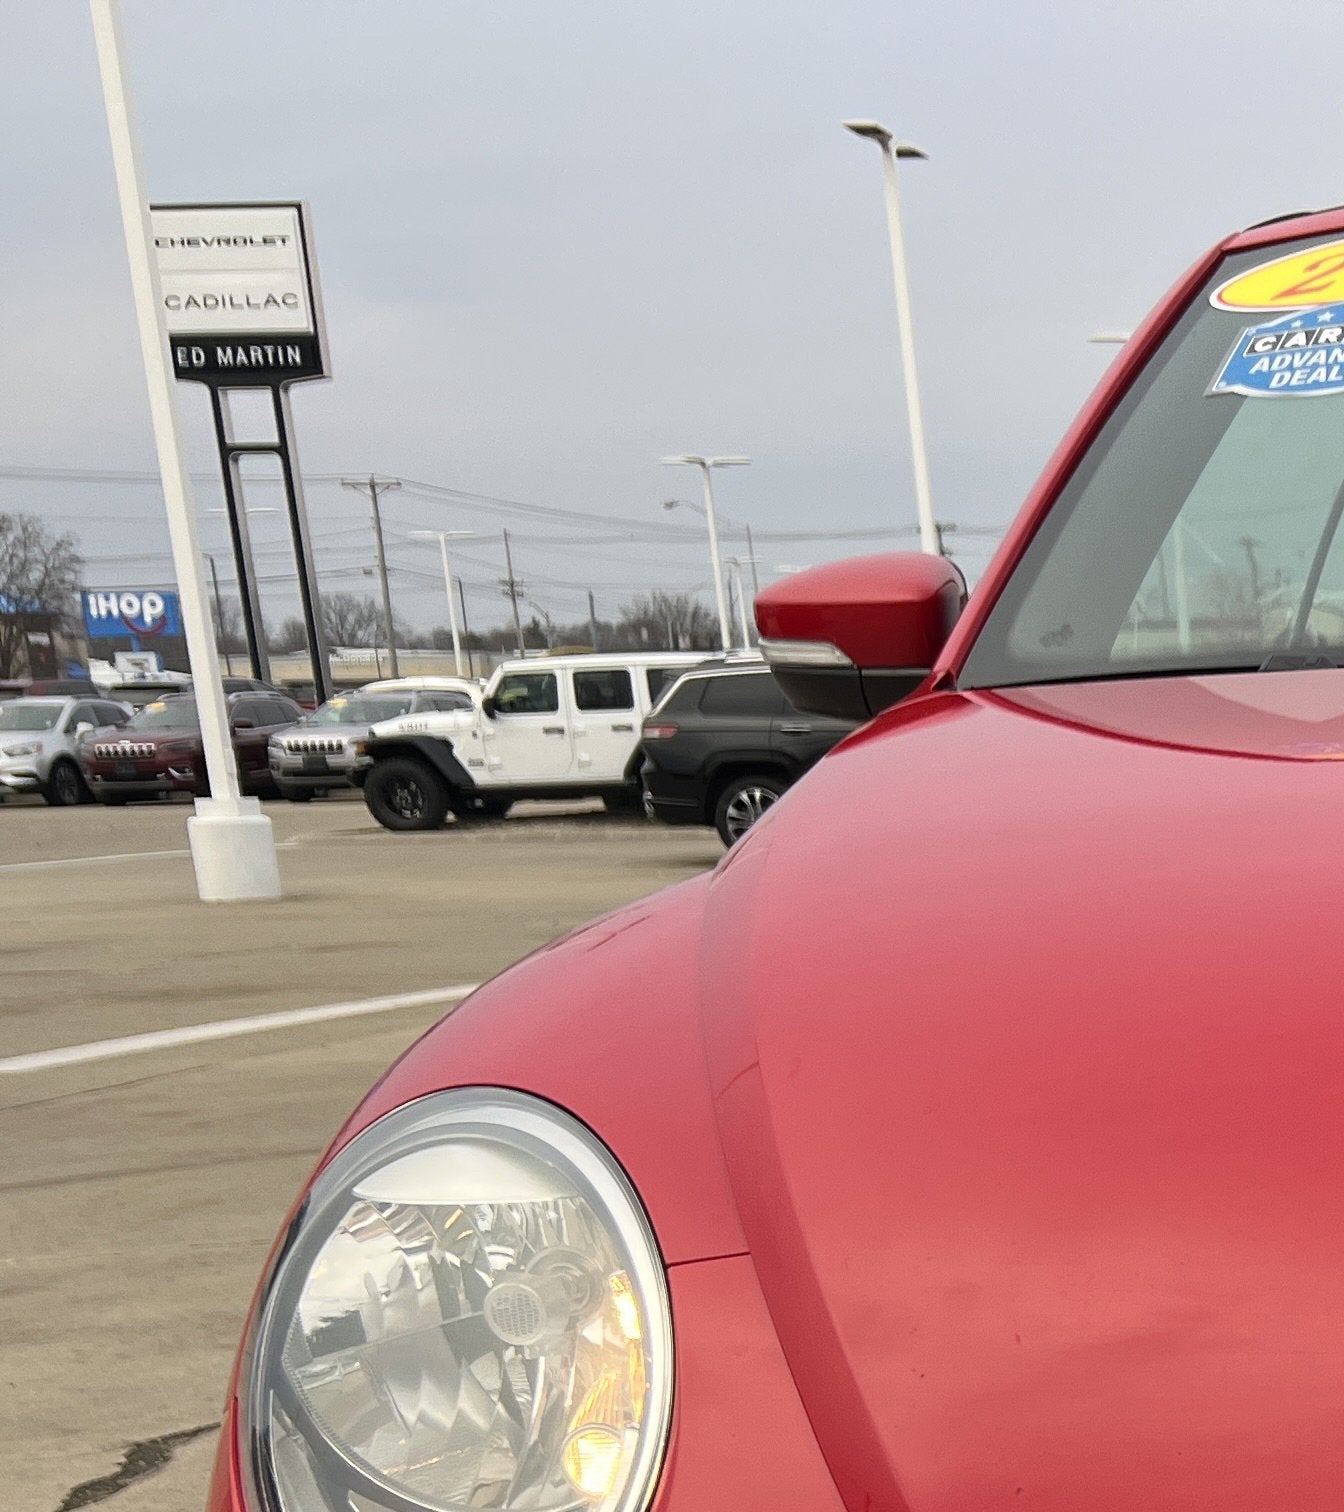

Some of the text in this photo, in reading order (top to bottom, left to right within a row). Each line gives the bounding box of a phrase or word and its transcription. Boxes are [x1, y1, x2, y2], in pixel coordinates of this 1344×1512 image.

[154, 235, 290, 248] CHEVROLET
[164, 293, 299, 310] CADILLAC
[176, 344, 301, 368] ED MARTIN
[87, 592, 165, 627] IHOP
